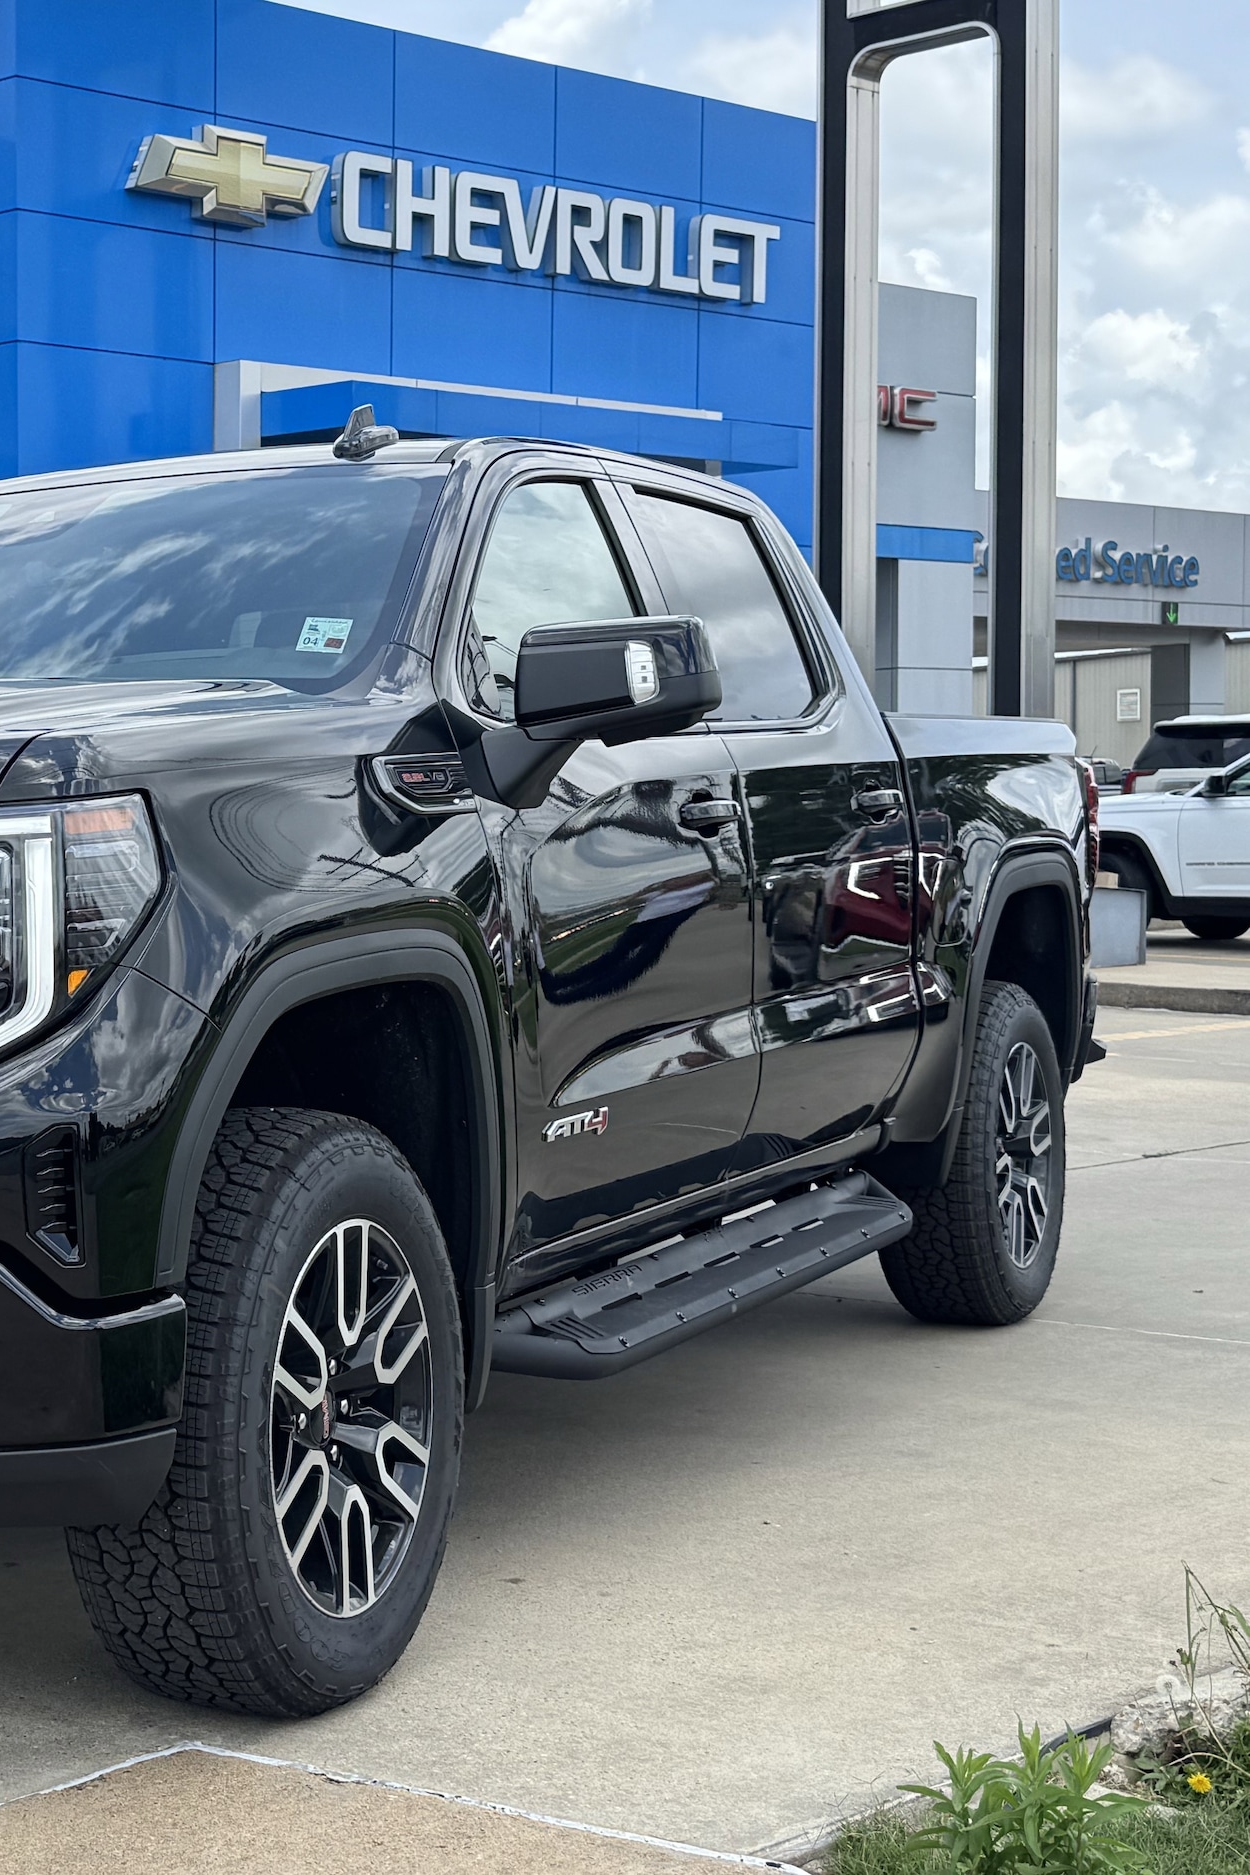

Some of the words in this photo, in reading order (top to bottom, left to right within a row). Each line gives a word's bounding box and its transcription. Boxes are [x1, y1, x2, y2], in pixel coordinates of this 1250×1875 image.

[332, 150, 781, 305] CHEVROLET
[1096, 540, 1199, 588] Service
[541, 1106, 609, 1142] AT4
[571, 1264, 643, 1296] SIERRA
